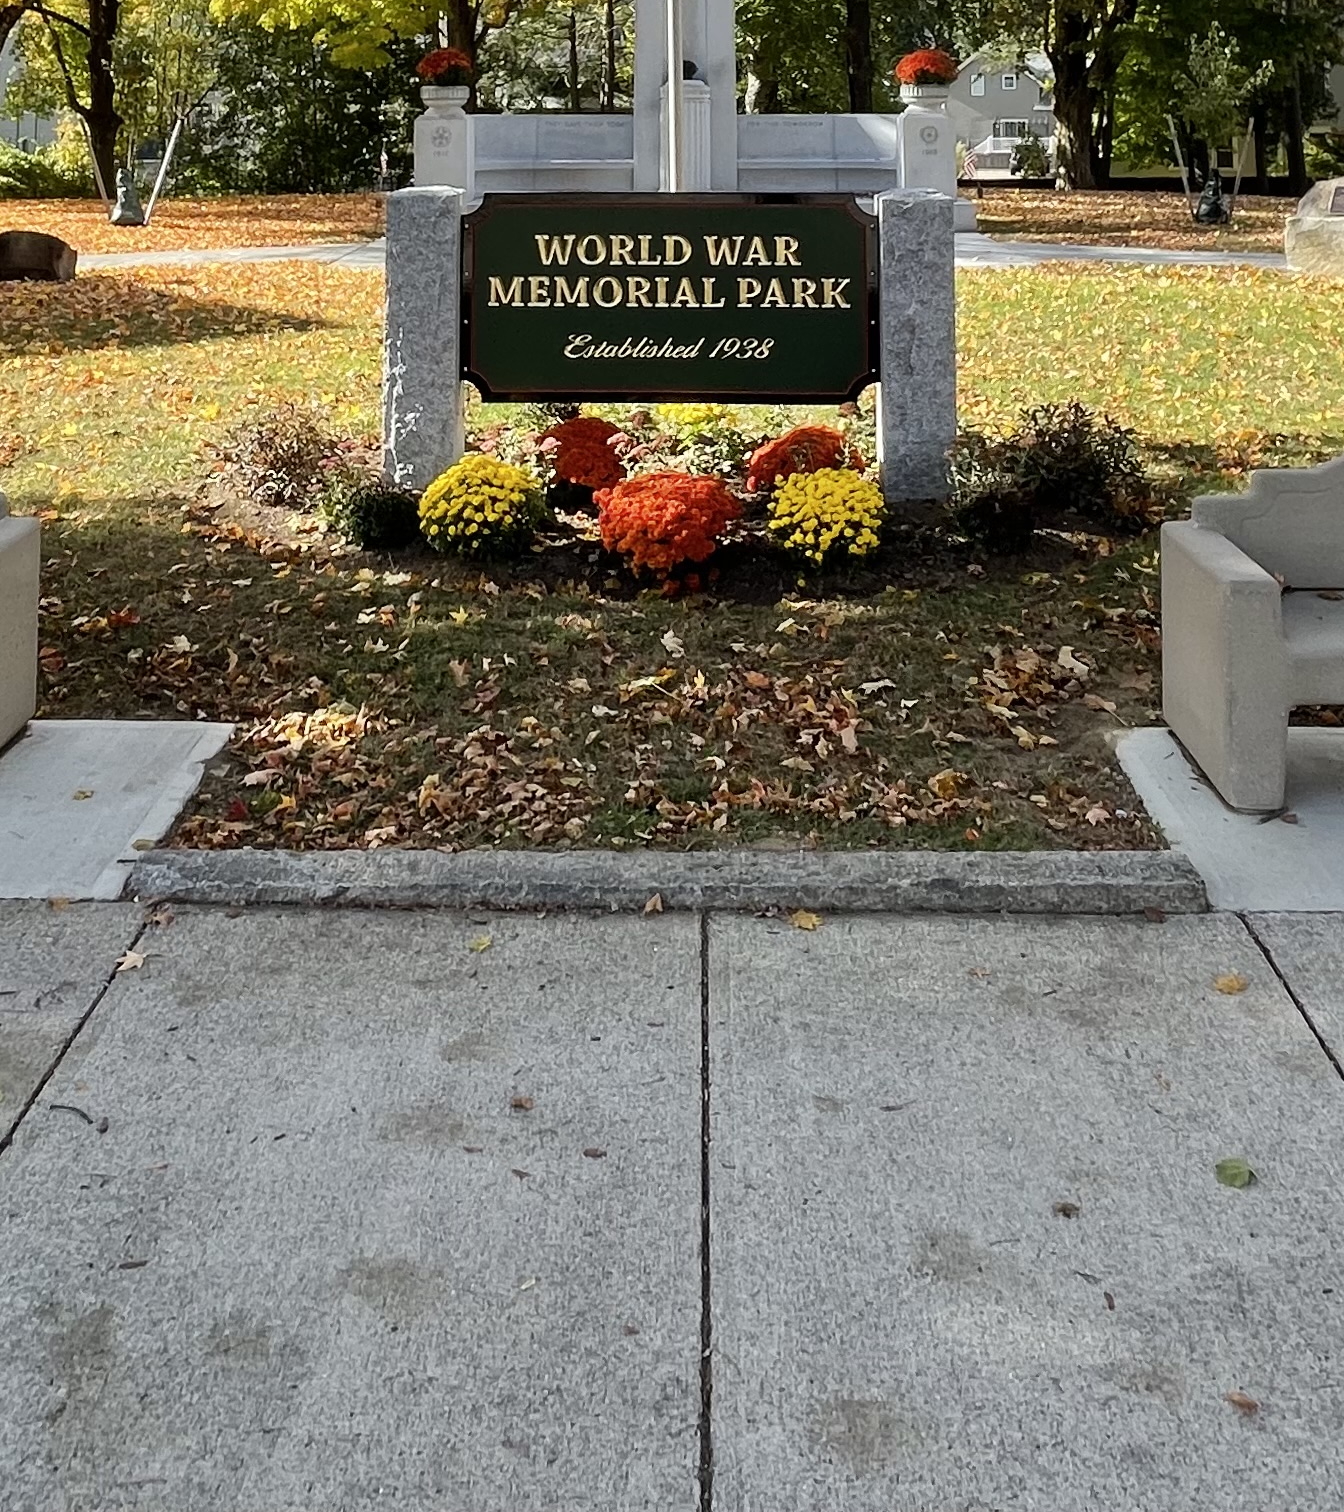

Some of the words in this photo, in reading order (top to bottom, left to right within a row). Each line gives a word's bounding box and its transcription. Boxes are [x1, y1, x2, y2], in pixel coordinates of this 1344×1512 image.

[534, 233, 692, 266] WORLD
[703, 233, 802, 266] WAR
[487, 275, 726, 308] MEMORIAL
[737, 276, 852, 309] PARK
[563, 334, 705, 360] Established
[709, 337, 775, 359] 1938
